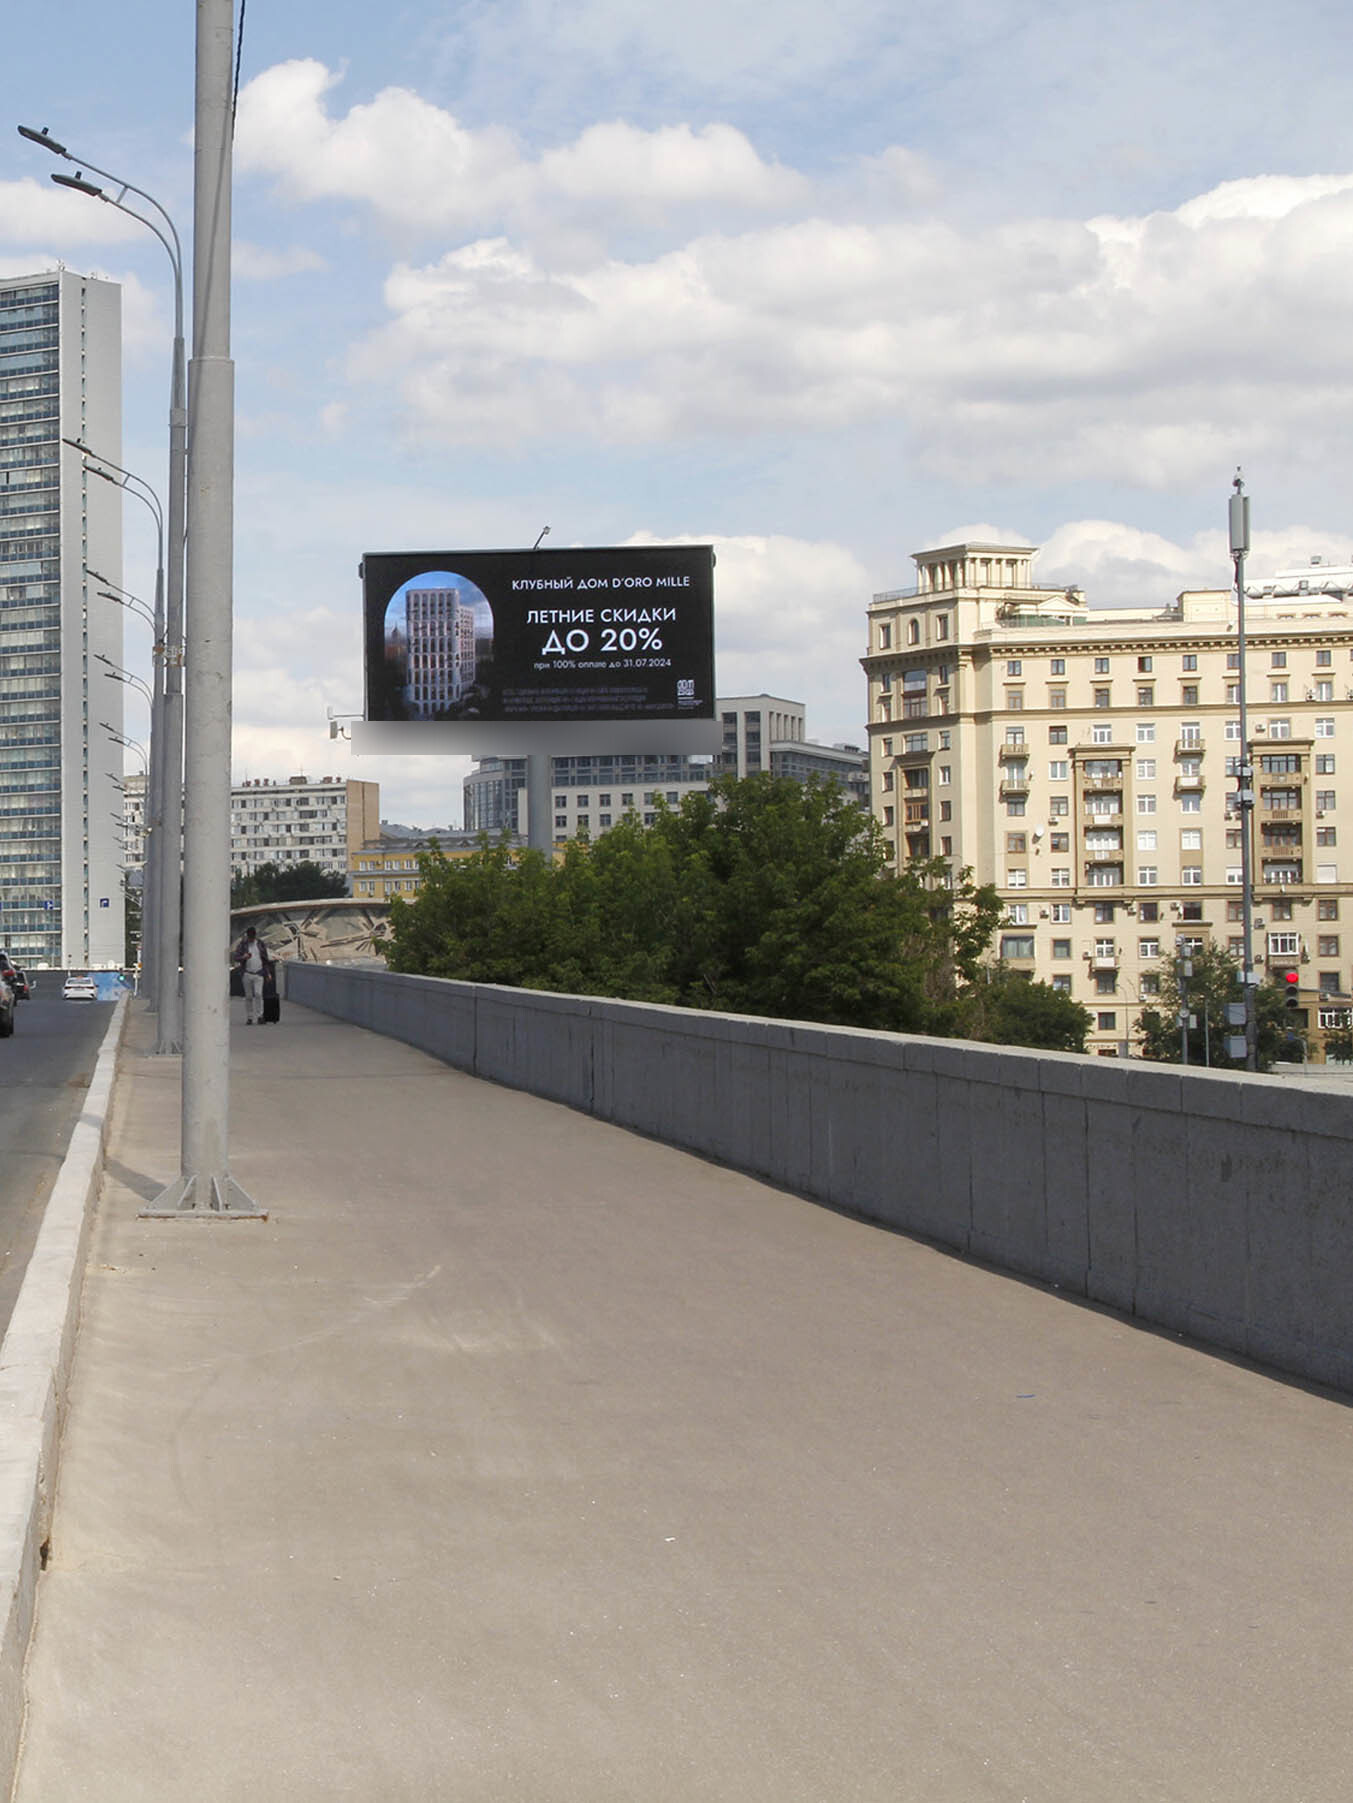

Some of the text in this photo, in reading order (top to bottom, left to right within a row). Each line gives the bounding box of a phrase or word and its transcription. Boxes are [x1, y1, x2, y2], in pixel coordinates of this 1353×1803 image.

[512, 576, 574, 590] КЛУБНЫЙ
[577, 577, 608, 590] ДОМ
[656, 576, 690, 588] MILLE
[527, 608, 676, 624] ЛЕТНИЕ СКИДКИ
[542, 627, 663, 655] ДО 20%
[553, 660, 576, 669] 100%
[623, 659, 671, 669] 31.07.2024
